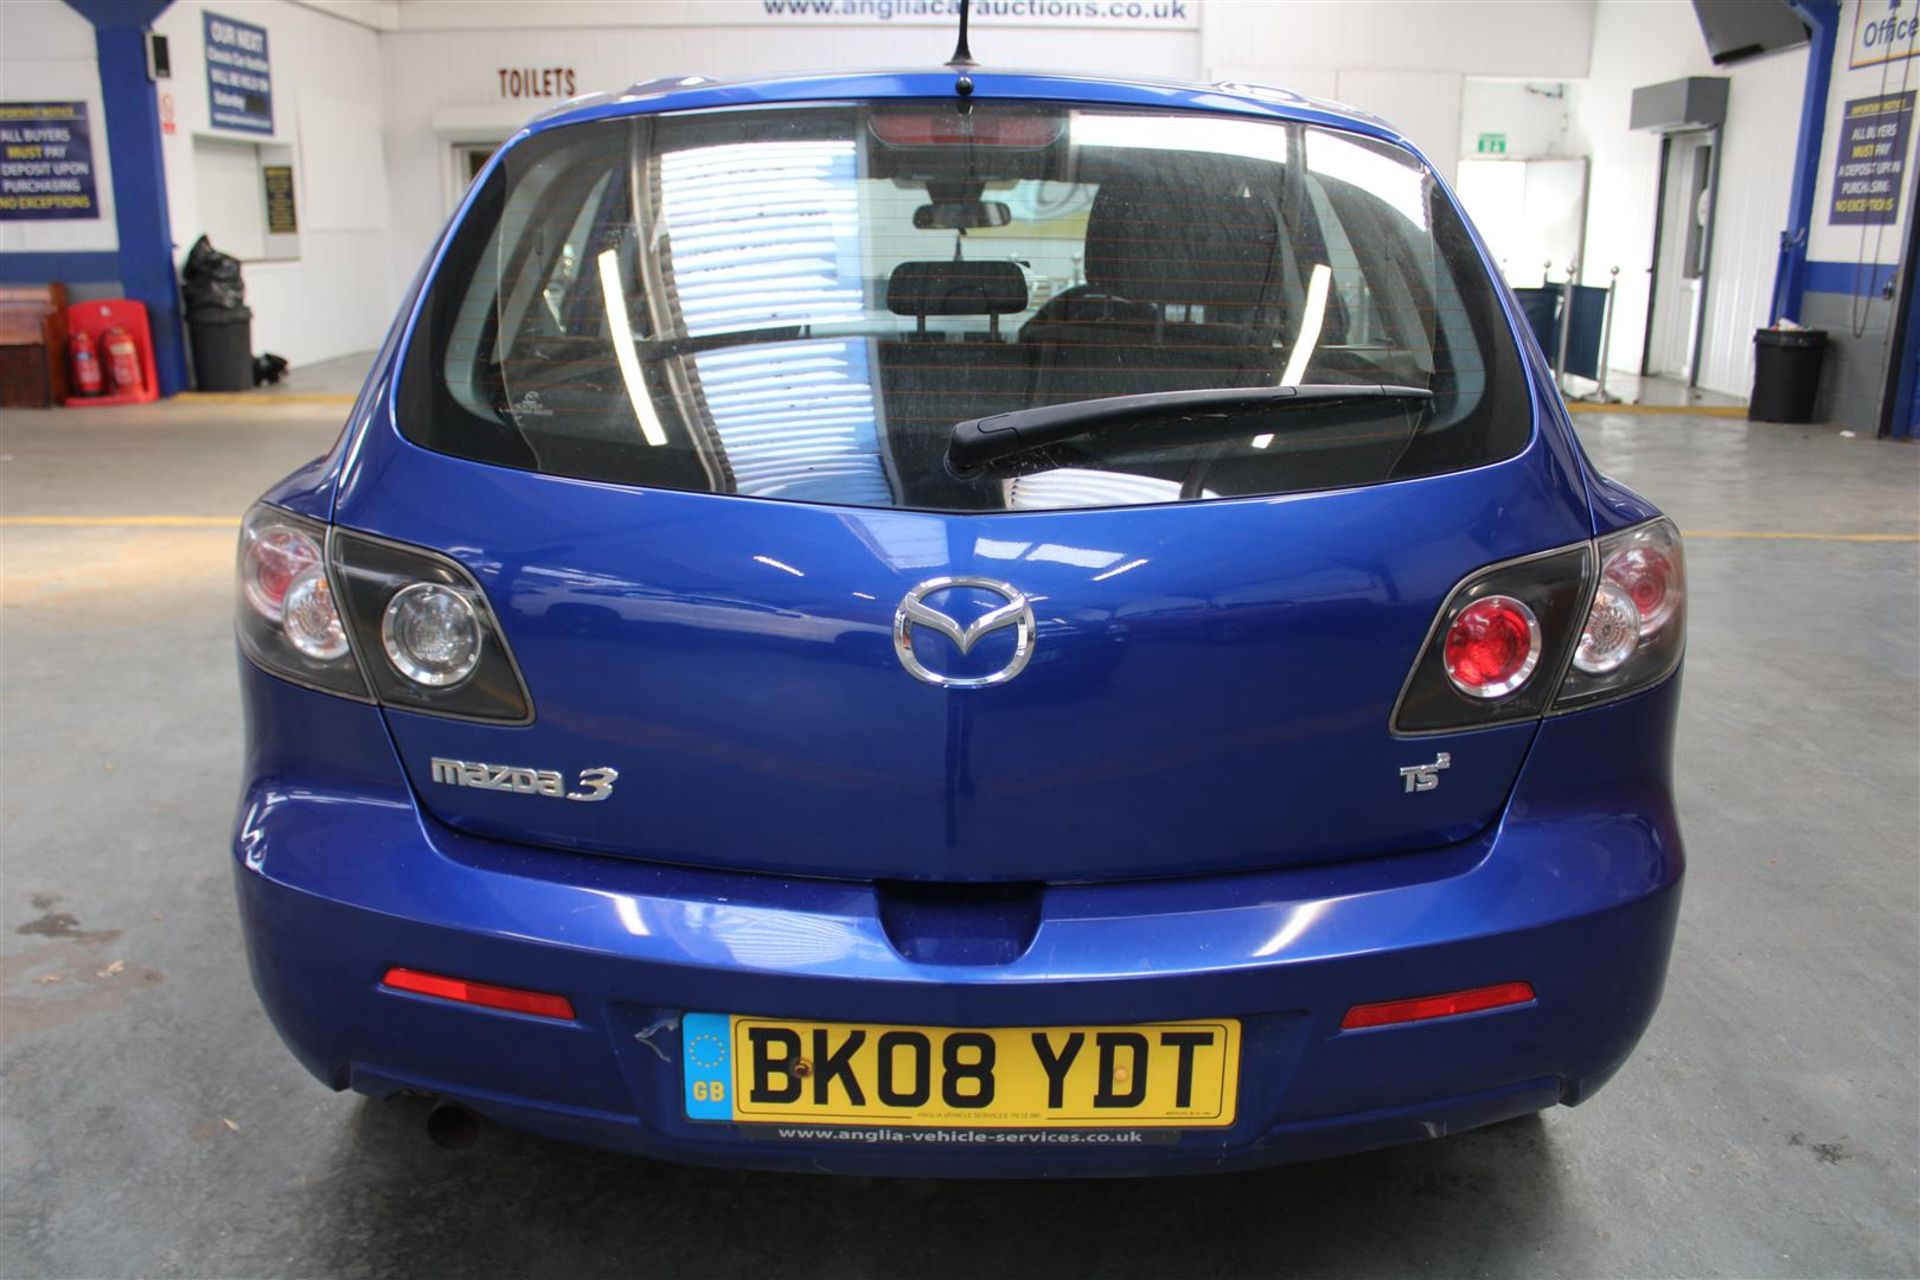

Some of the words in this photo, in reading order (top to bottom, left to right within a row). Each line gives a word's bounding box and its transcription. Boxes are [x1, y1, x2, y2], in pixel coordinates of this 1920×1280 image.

[764, 0, 1186, 19] www.angliacaauctions.co.uk
[1864, 16, 1919, 47] Office
[498, 69, 576, 98] TOILETS
[0, 129, 22, 143] ALL
[22, 128, 71, 143] BUYERS
[1852, 127, 1867, 141] ALL
[6, 145, 42, 159] MUST
[43, 144, 67, 159] PAY
[1874, 141, 1892, 156] PAY
[0, 161, 51, 177] DEPOSIT
[51, 161, 90, 176] UPON
[2, 178, 82, 194] PURCHASING
[18, 194, 91, 210] EXCEPTIONS
[566, 767, 619, 801] 3
[748, 1027, 996, 1109] BK08
[1031, 1032, 1214, 1109] YDT
[693, 1081, 725, 1102] GB
[778, 1127, 1143, 1143] www.anglia-vehicle-services.co.uk
